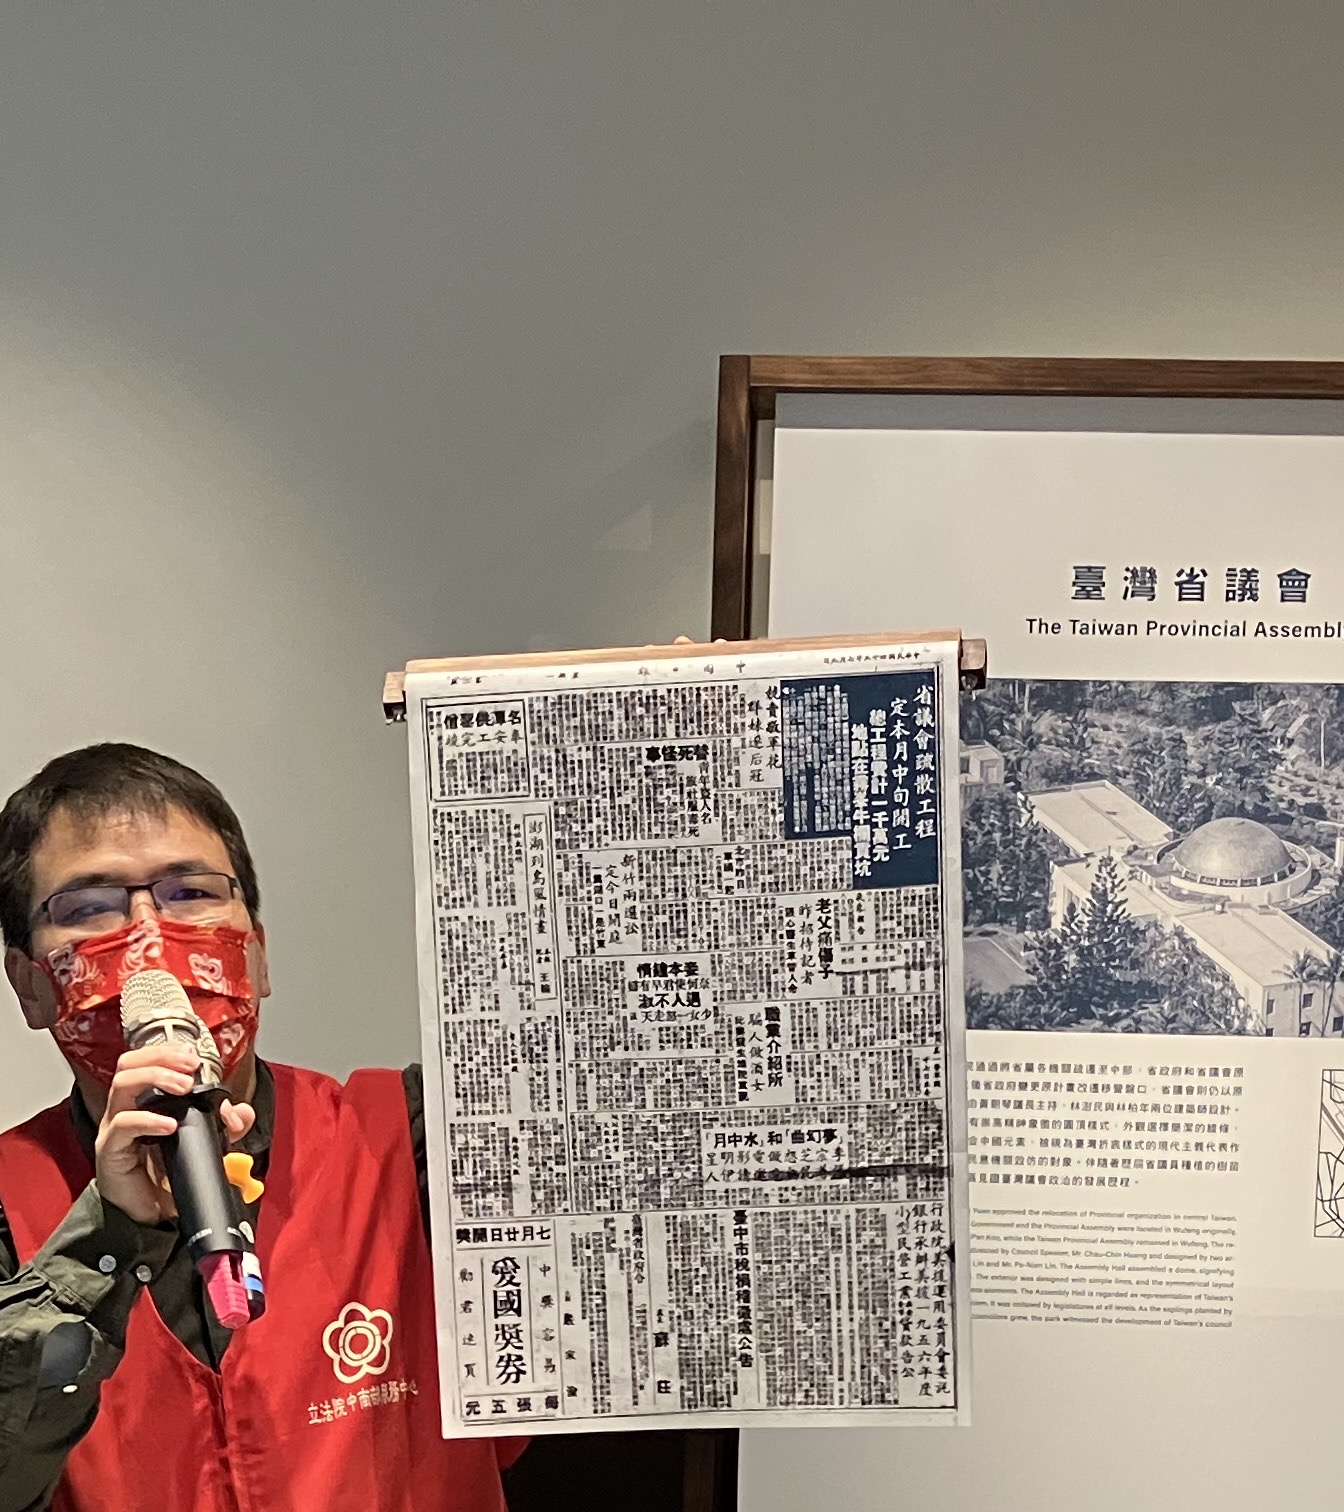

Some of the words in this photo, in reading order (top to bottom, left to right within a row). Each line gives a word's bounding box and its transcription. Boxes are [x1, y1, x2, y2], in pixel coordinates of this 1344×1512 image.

[1072, 566, 1311, 603] 臺灣省議會
[1026, 618, 1061, 635] The
[1069, 619, 1137, 636] Taiwan
[1147, 619, 1246, 638] Provincial
[889, 698, 912, 850] 定本月中旬開工
[914, 684, 937, 839] 省議會疏散工程
[456, 1225, 552, 1244] 七月廿日開獎
[491, 1256, 526, 1386] 愛國獎券
[464, 1395, 560, 1417] 每張五元
